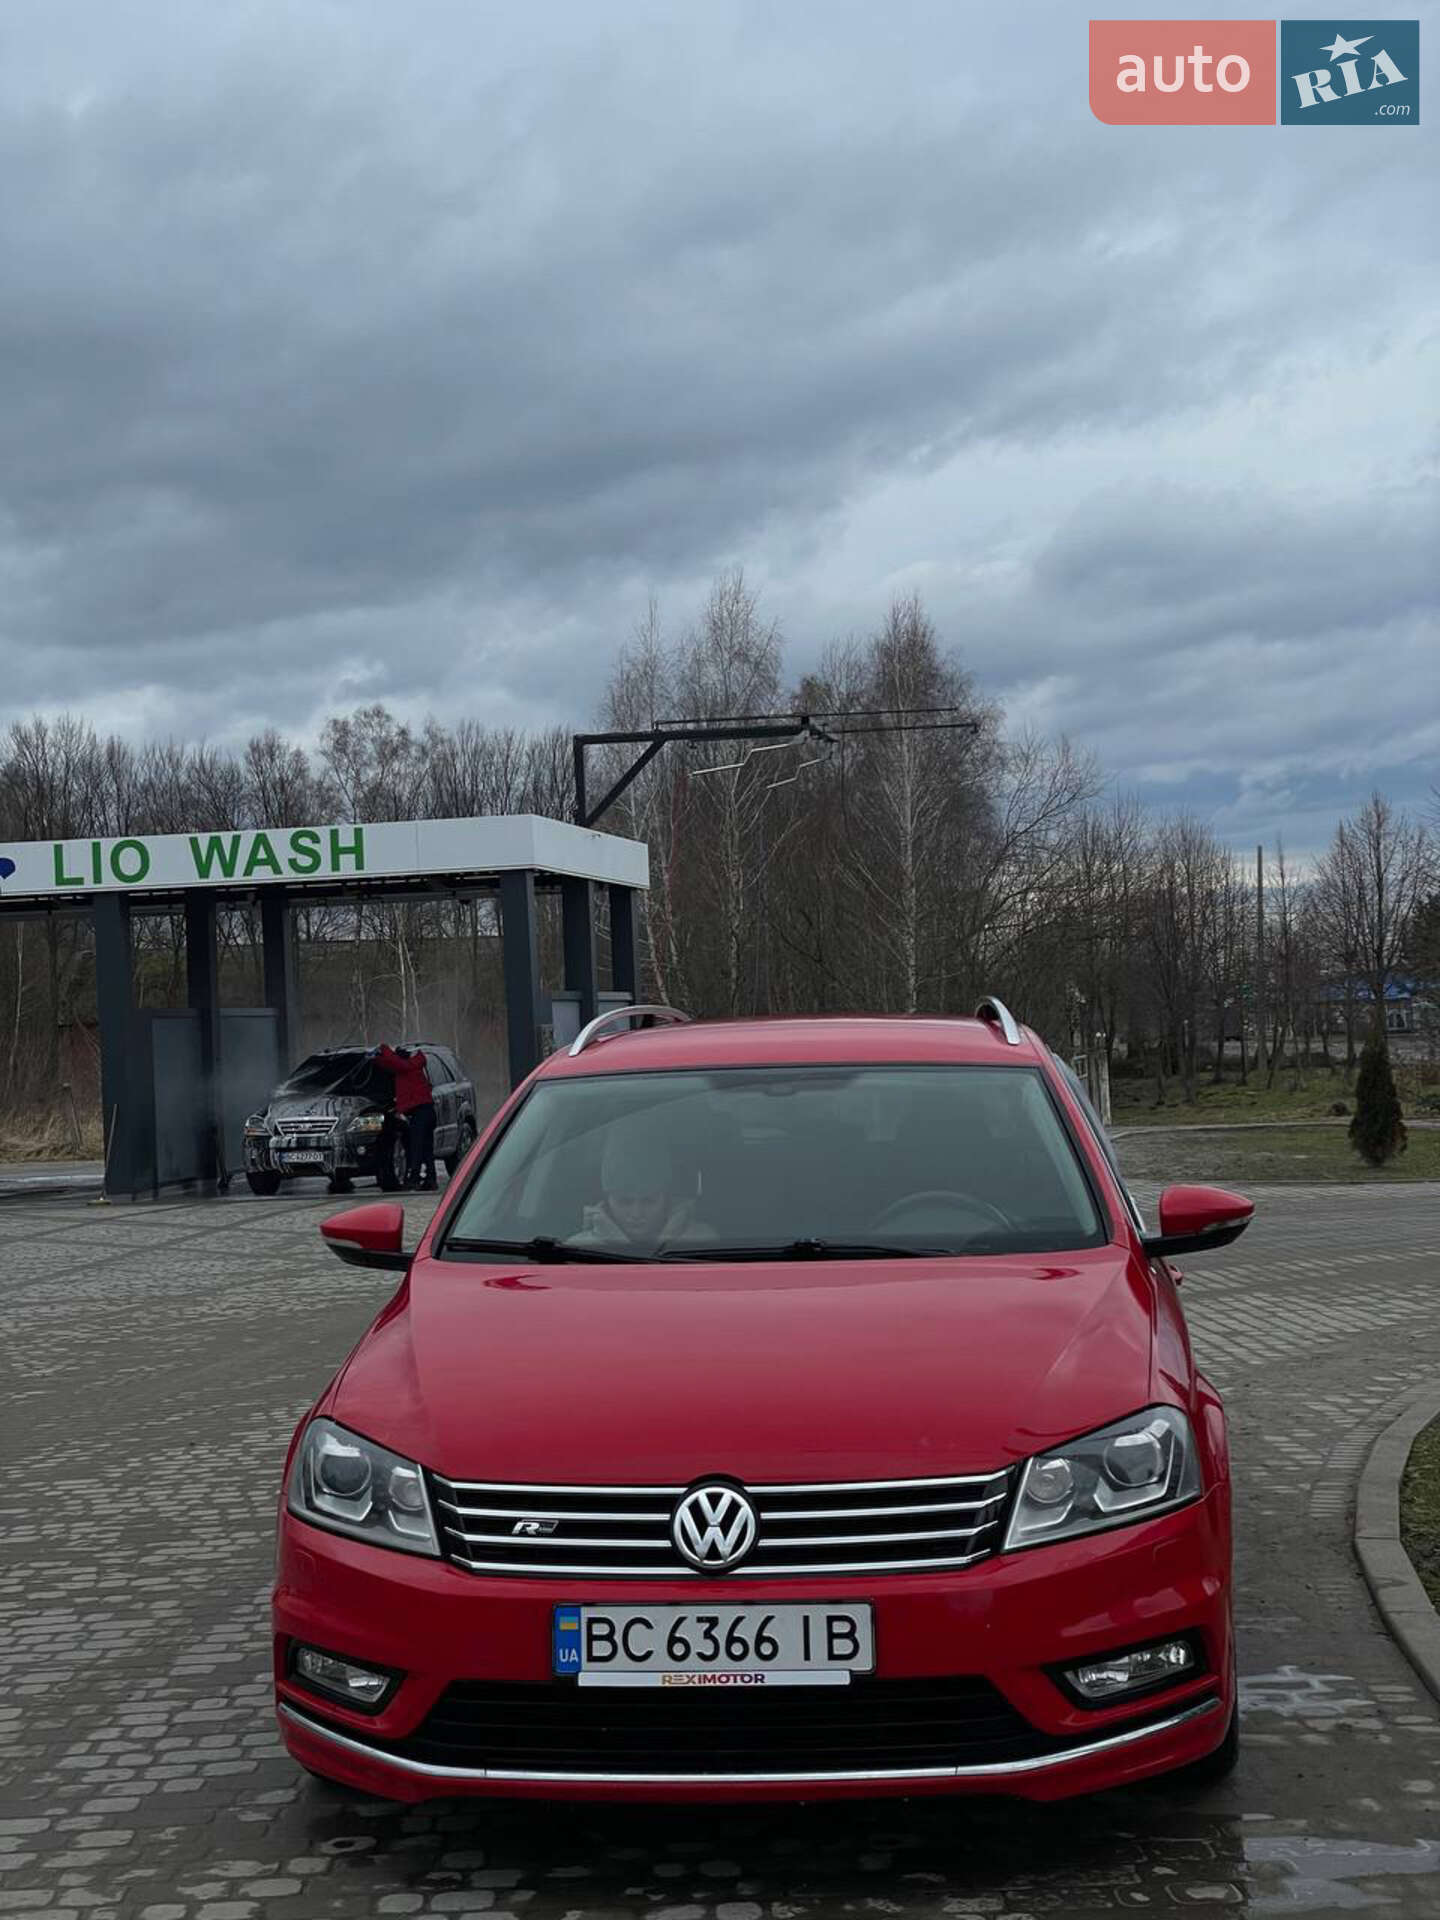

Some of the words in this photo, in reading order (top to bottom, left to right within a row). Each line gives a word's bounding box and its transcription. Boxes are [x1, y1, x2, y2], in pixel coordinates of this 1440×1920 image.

[53, 839, 151, 886] LIO
[188, 827, 365, 879] WASH
[585, 1616, 654, 1663] BC
[666, 1615, 779, 1663] 6366
[803, 1615, 860, 1661] IB
[559, 1649, 579, 1663] UA
[661, 1673, 765, 1686] REXIMOTOR
